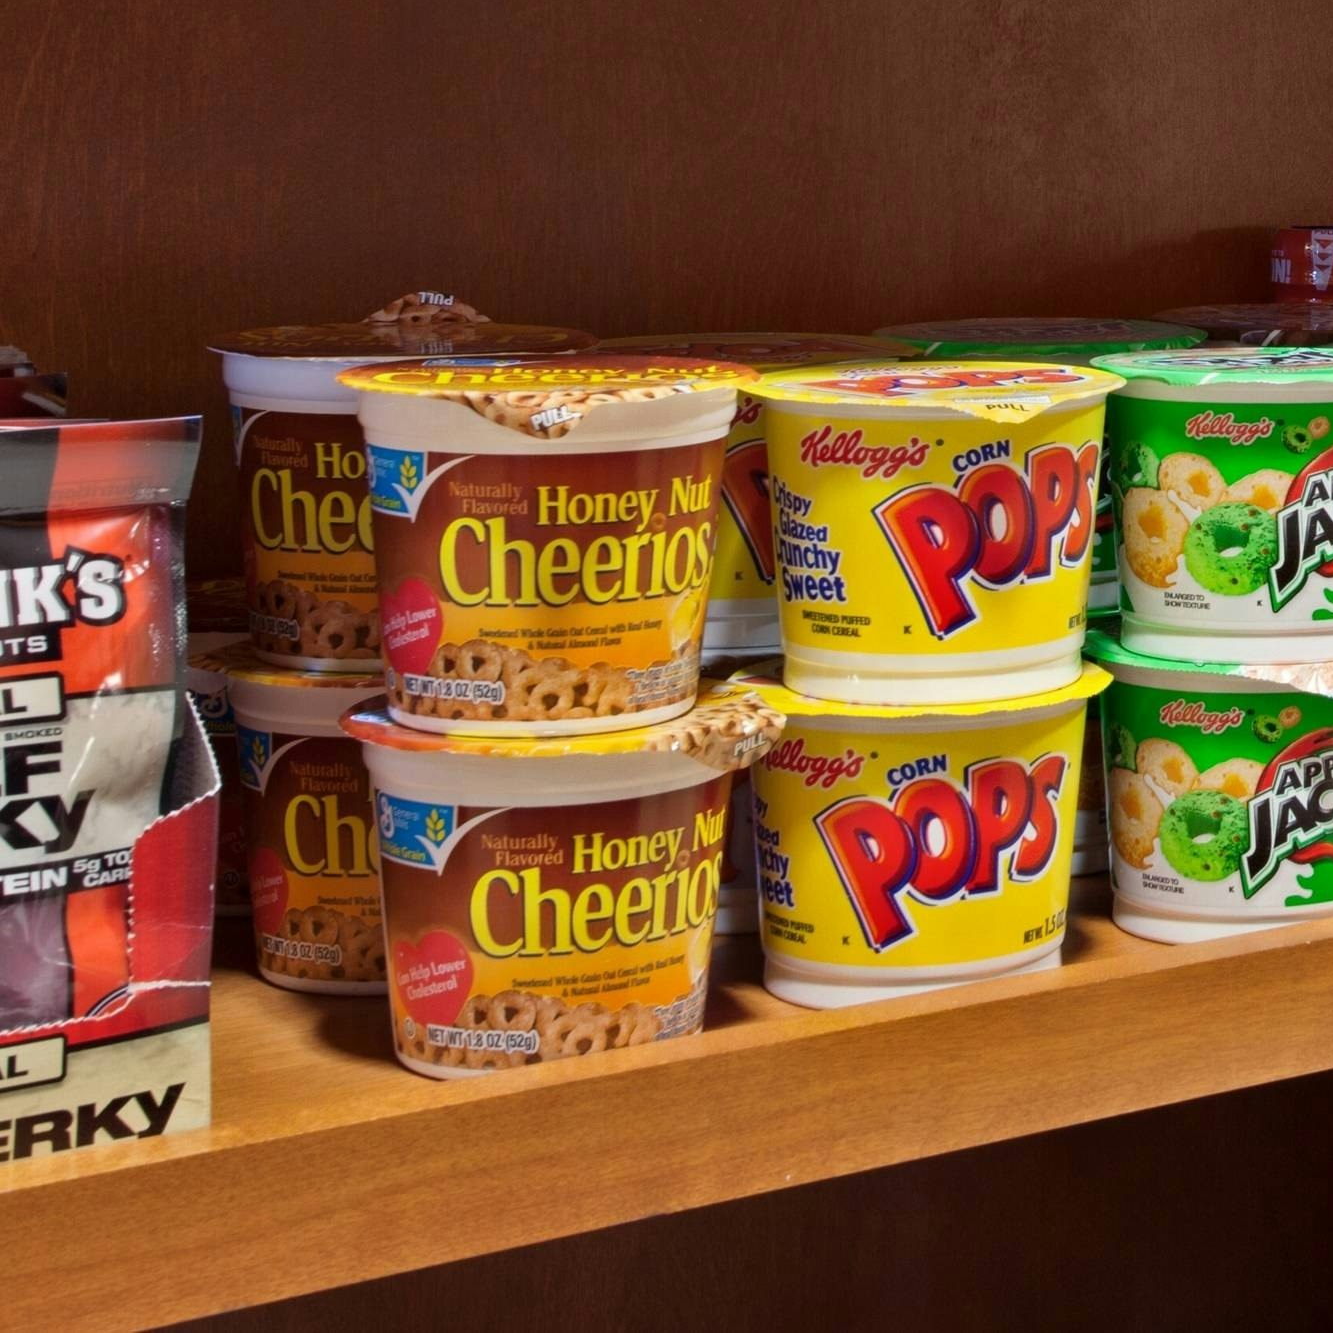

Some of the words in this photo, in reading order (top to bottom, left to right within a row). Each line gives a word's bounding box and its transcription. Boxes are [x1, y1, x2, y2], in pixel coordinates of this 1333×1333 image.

[528, 405, 572, 432] PULL
[1184, 410, 1276, 447] Kellogg's
[799, 425, 932, 480] Kellogg's
[951, 439, 1012, 474] CORN
[447, 481, 524, 502] Naturally
[462, 497, 529, 517] Flavored
[535, 483, 662, 535] Honey
[667, 474, 714, 512] Nut
[778, 513, 829, 545] Glazed
[871, 440, 1102, 642] POPS
[438, 514, 716, 610] Cheerios
[774, 529, 842, 577] Crunchy
[782, 566, 848, 603] Sweet
[832, 624, 862, 639] CEREAL
[840, 613, 872, 627] PUFFED
[472, 680, 505, 704] (52g)
[1158, 699, 1245, 734] Kellogg's
[4, 727, 64, 742] SMOKED
[886, 753, 948, 787] CORN
[571, 825, 686, 875] Honey
[692, 805, 728, 853] Nut
[812, 751, 1070, 954] POPS
[468, 848, 726, 960] Cheerios
